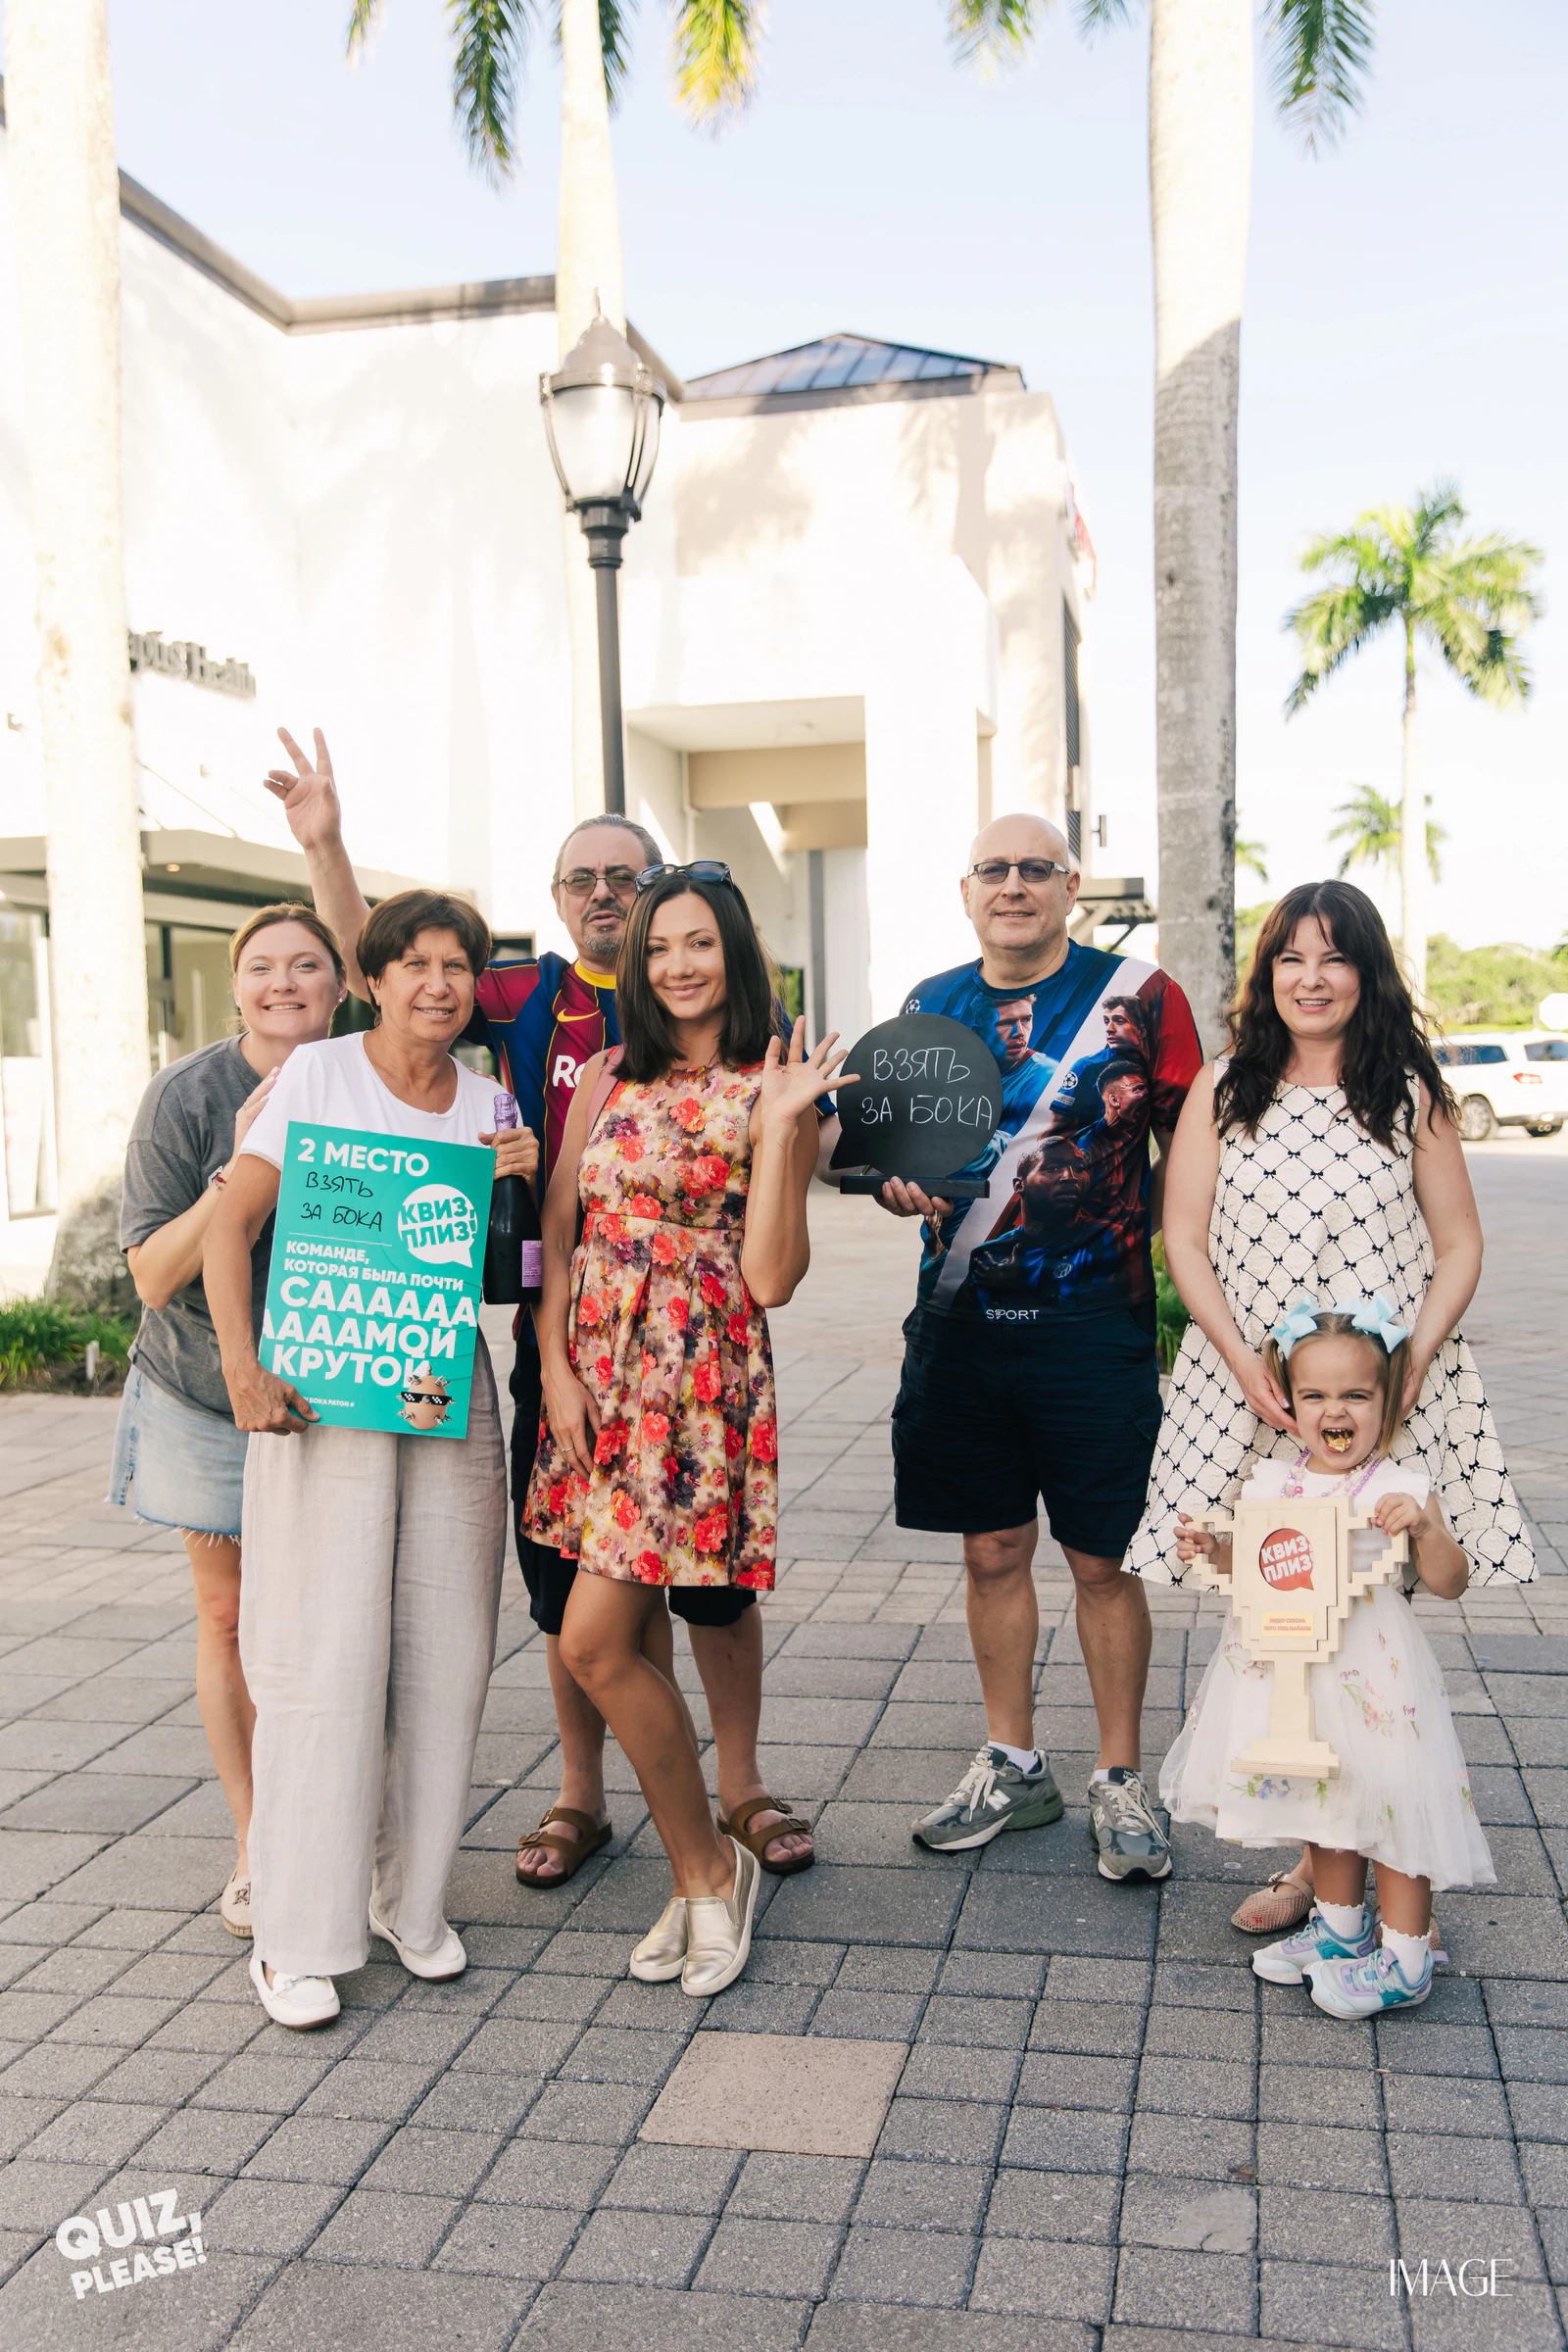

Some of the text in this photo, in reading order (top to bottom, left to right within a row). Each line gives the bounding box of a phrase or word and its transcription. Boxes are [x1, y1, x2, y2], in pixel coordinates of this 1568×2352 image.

[873, 1048, 970, 1084] ВЗЯТЬ
[860, 1094, 993, 1130] ЗА БОКА
[297, 1138, 430, 1177] 2 МЕСТО
[306, 1171, 373, 1198] ВЗЯТЬ
[301, 1202, 382, 1232] ЗА БОКА
[401, 1220, 476, 1249] ПЛИЗ!
[286, 1241, 369, 1264] КОМАНДЕ,
[284, 1258, 465, 1292] КОТОРАЯ БЫЛА ПОЧТИ
[985, 1308, 1040, 1320] SPORT
[309, 1396, 328, 1405] БОКА
[328, 1398, 350, 1407] РАТОН
